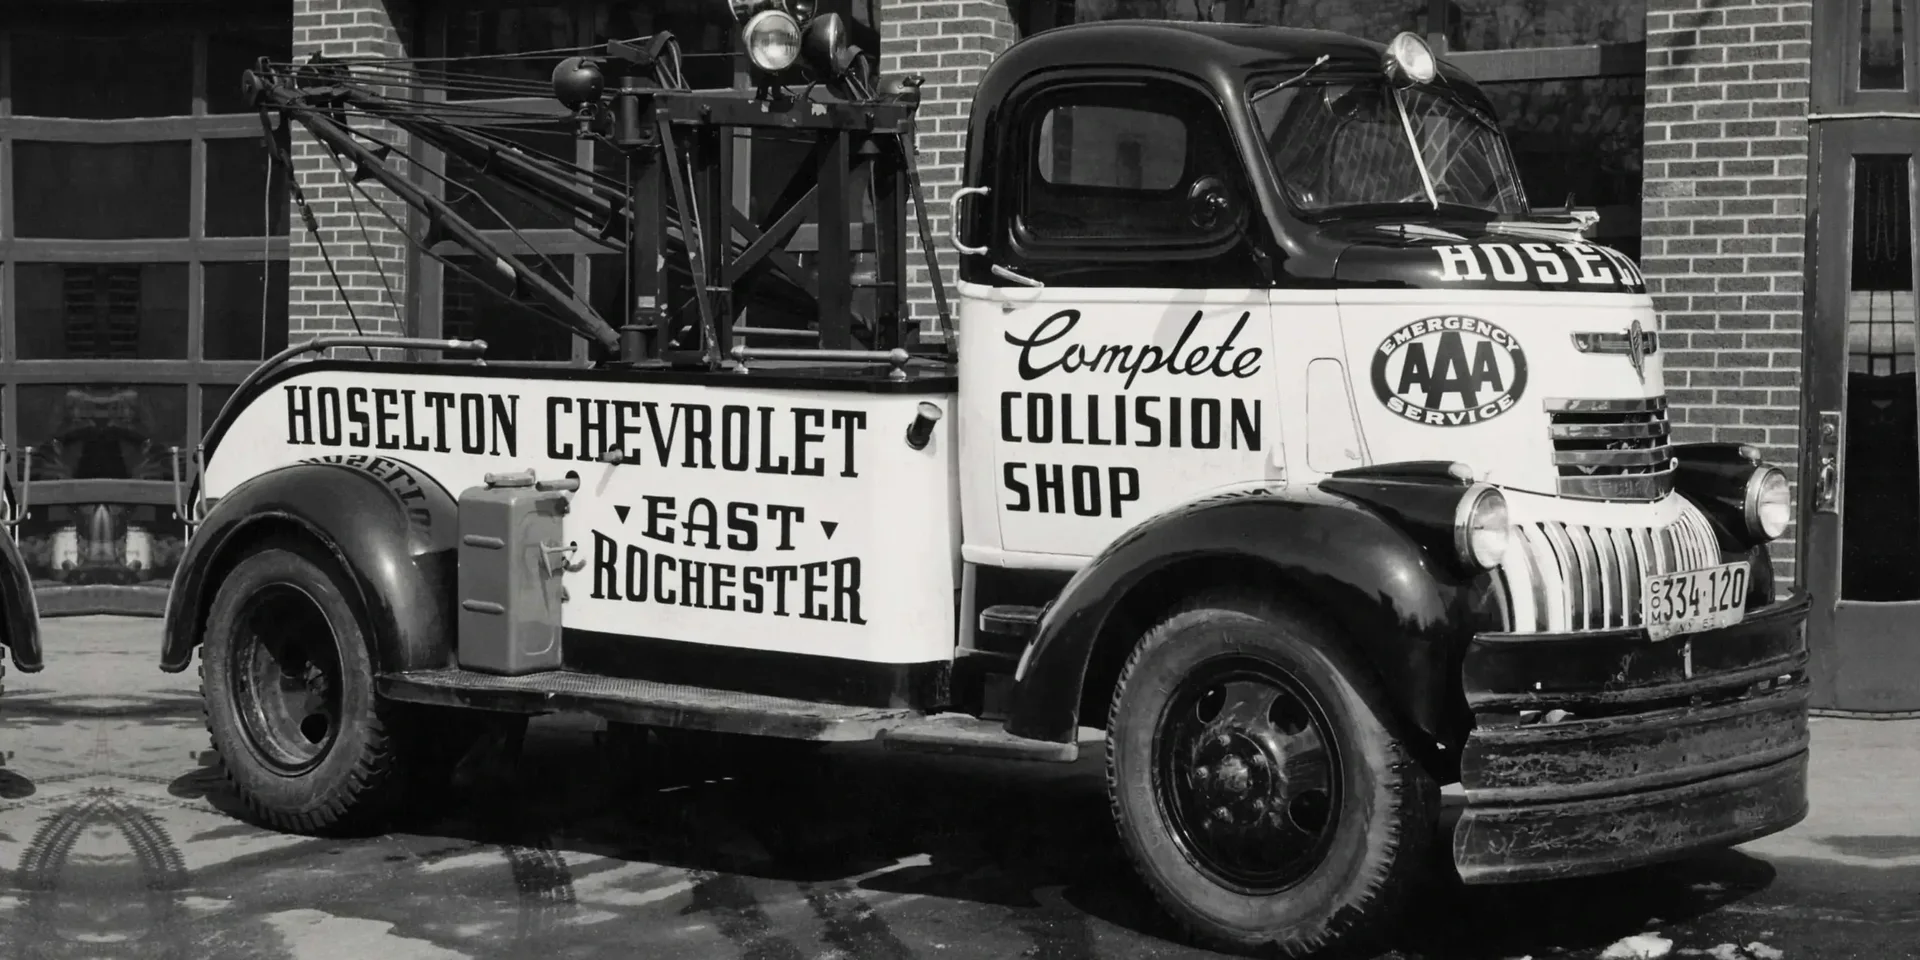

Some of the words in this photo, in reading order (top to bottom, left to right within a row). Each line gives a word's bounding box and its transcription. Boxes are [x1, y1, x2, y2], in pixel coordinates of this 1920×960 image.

[1004, 309, 1263, 390] Complete
[1380, 316, 1520, 356] EMERGENCY
[1397, 331, 1505, 410] AAA
[284, 385, 520, 457] HOSELTON
[546, 396, 867, 478] CHEVROLET
[1001, 391, 1262, 451] COLLISION
[1386, 393, 1515, 426] SERVICE
[1003, 462, 1140, 518] SHOP
[642, 495, 805, 552] EAST
[590, 529, 868, 626] ROCHESTER
